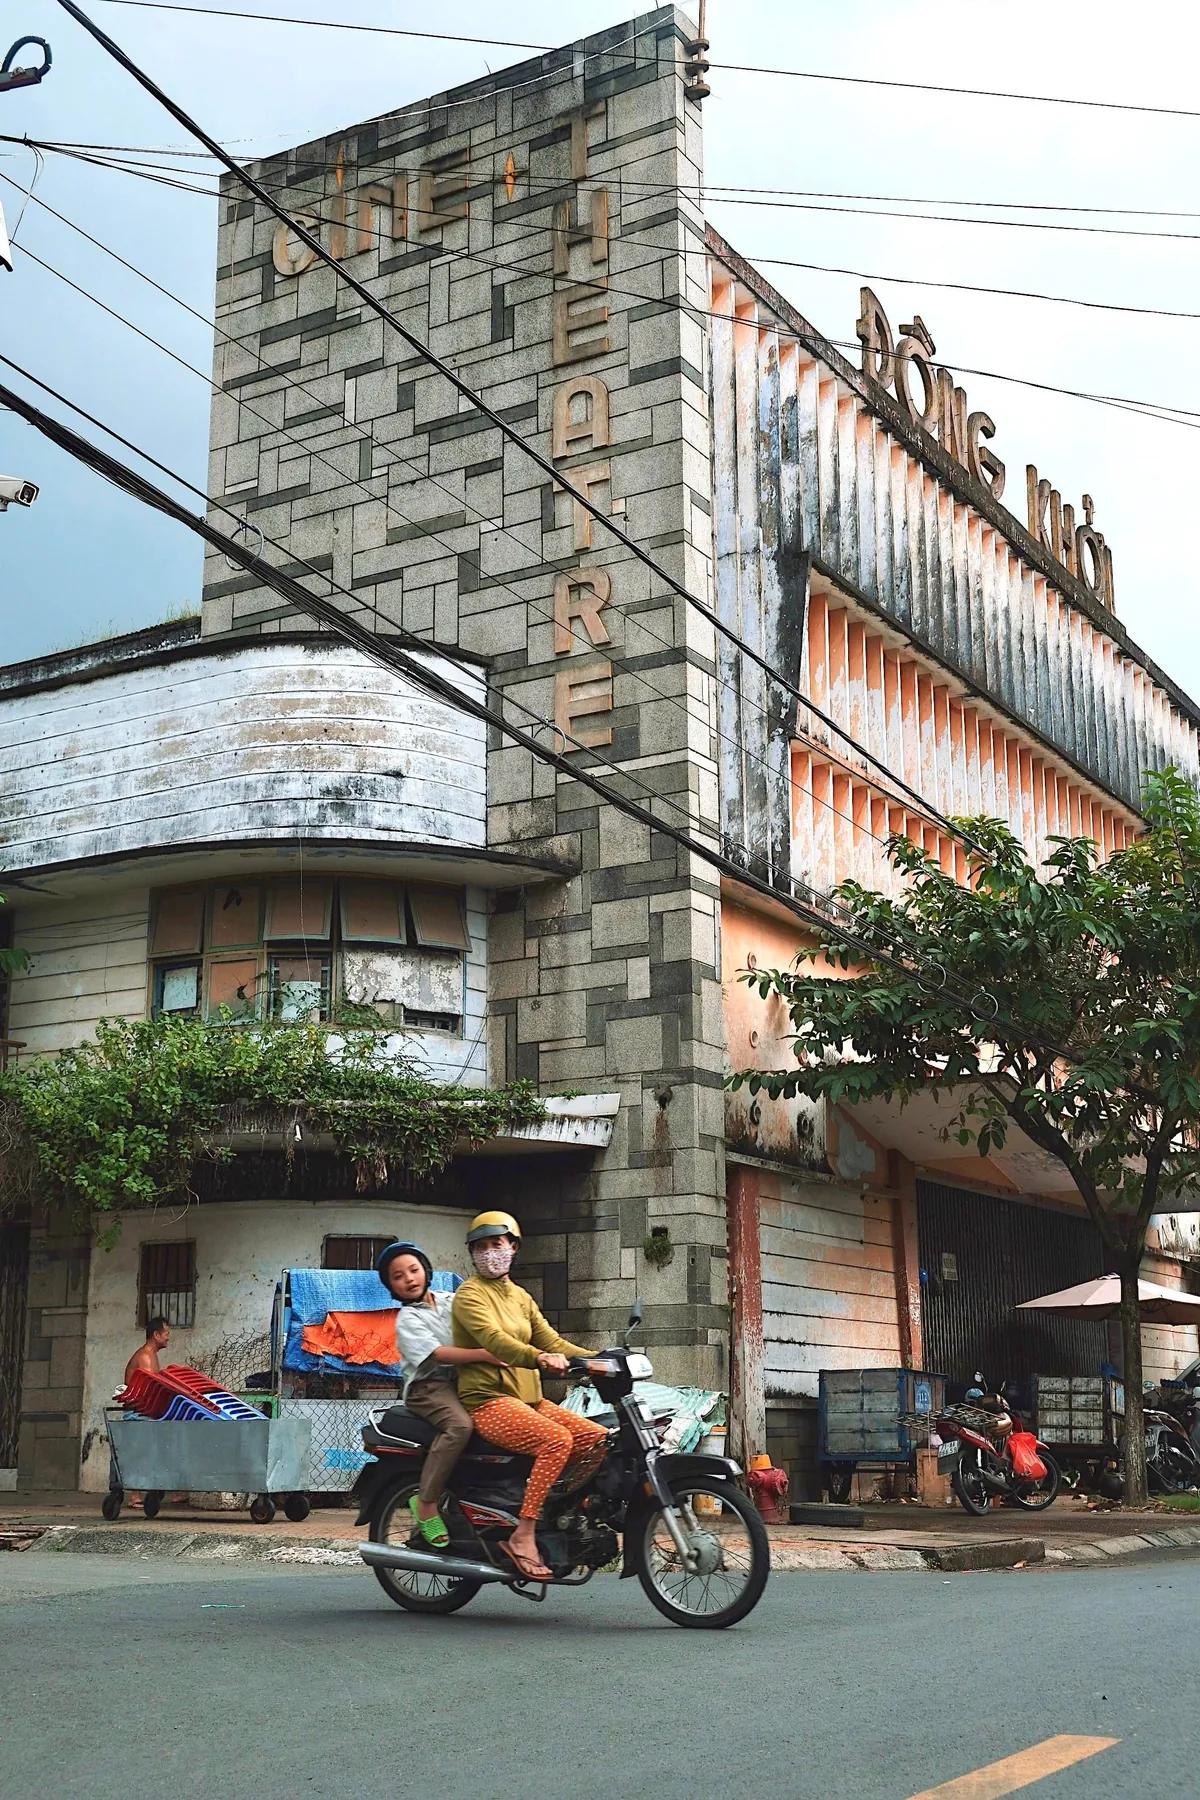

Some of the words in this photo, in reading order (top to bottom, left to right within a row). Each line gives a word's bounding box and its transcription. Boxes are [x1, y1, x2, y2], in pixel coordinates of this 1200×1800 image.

[551, 98, 613, 753] THEATRE
[856, 286, 1006, 501] ĐỒNG
[1026, 464, 1116, 616] KHỞI
